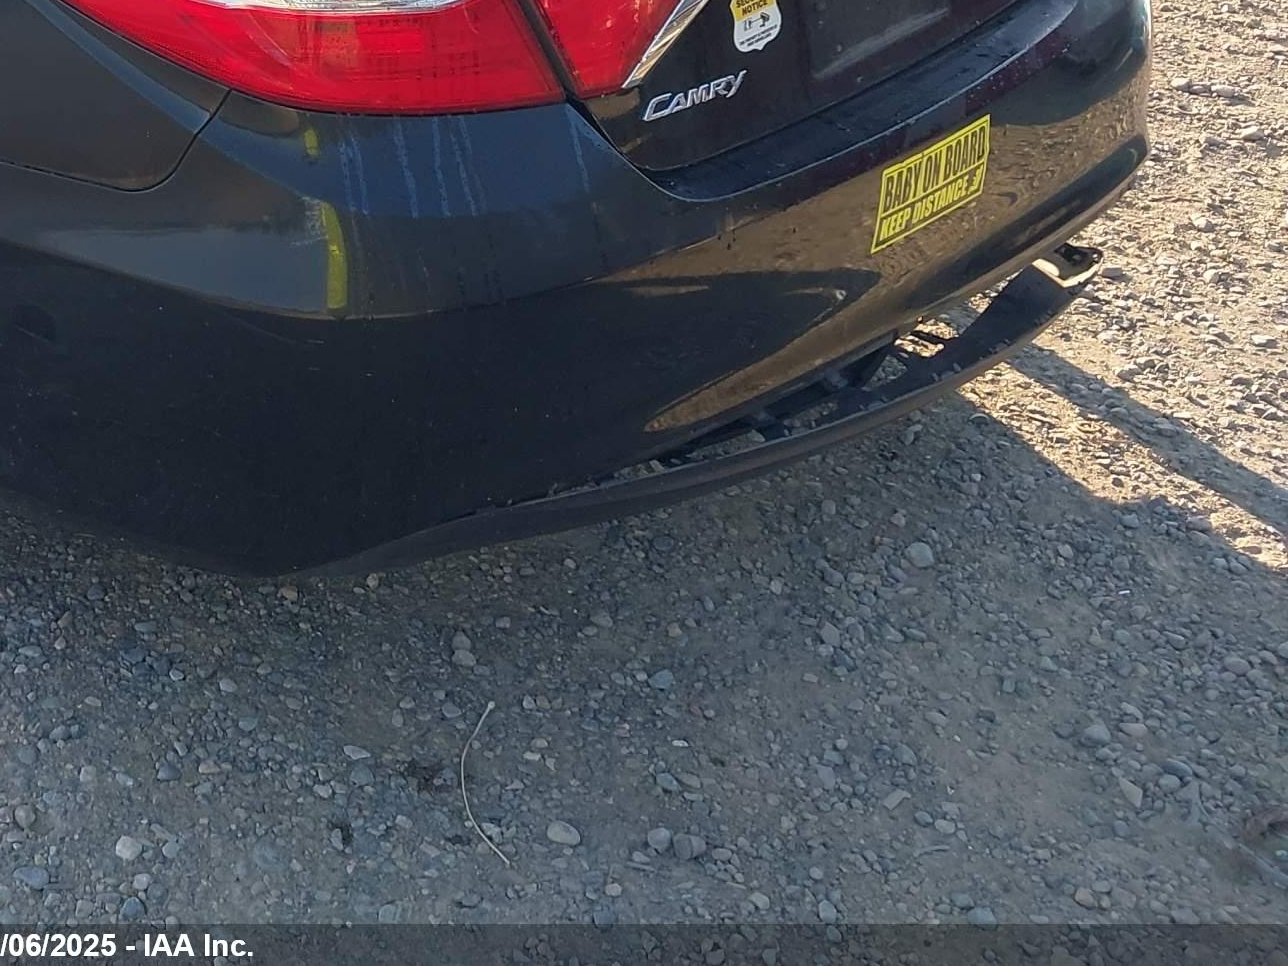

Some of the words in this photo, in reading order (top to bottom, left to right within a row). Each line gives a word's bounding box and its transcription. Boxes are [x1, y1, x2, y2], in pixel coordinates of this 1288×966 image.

[643, 69, 748, 122] CAMRY
[883, 160, 922, 212] BABY
[921, 149, 943, 194] ON
[942, 125, 986, 183] BOARD
[879, 207, 912, 241] KEEP
[911, 175, 969, 224] DISTANCE
